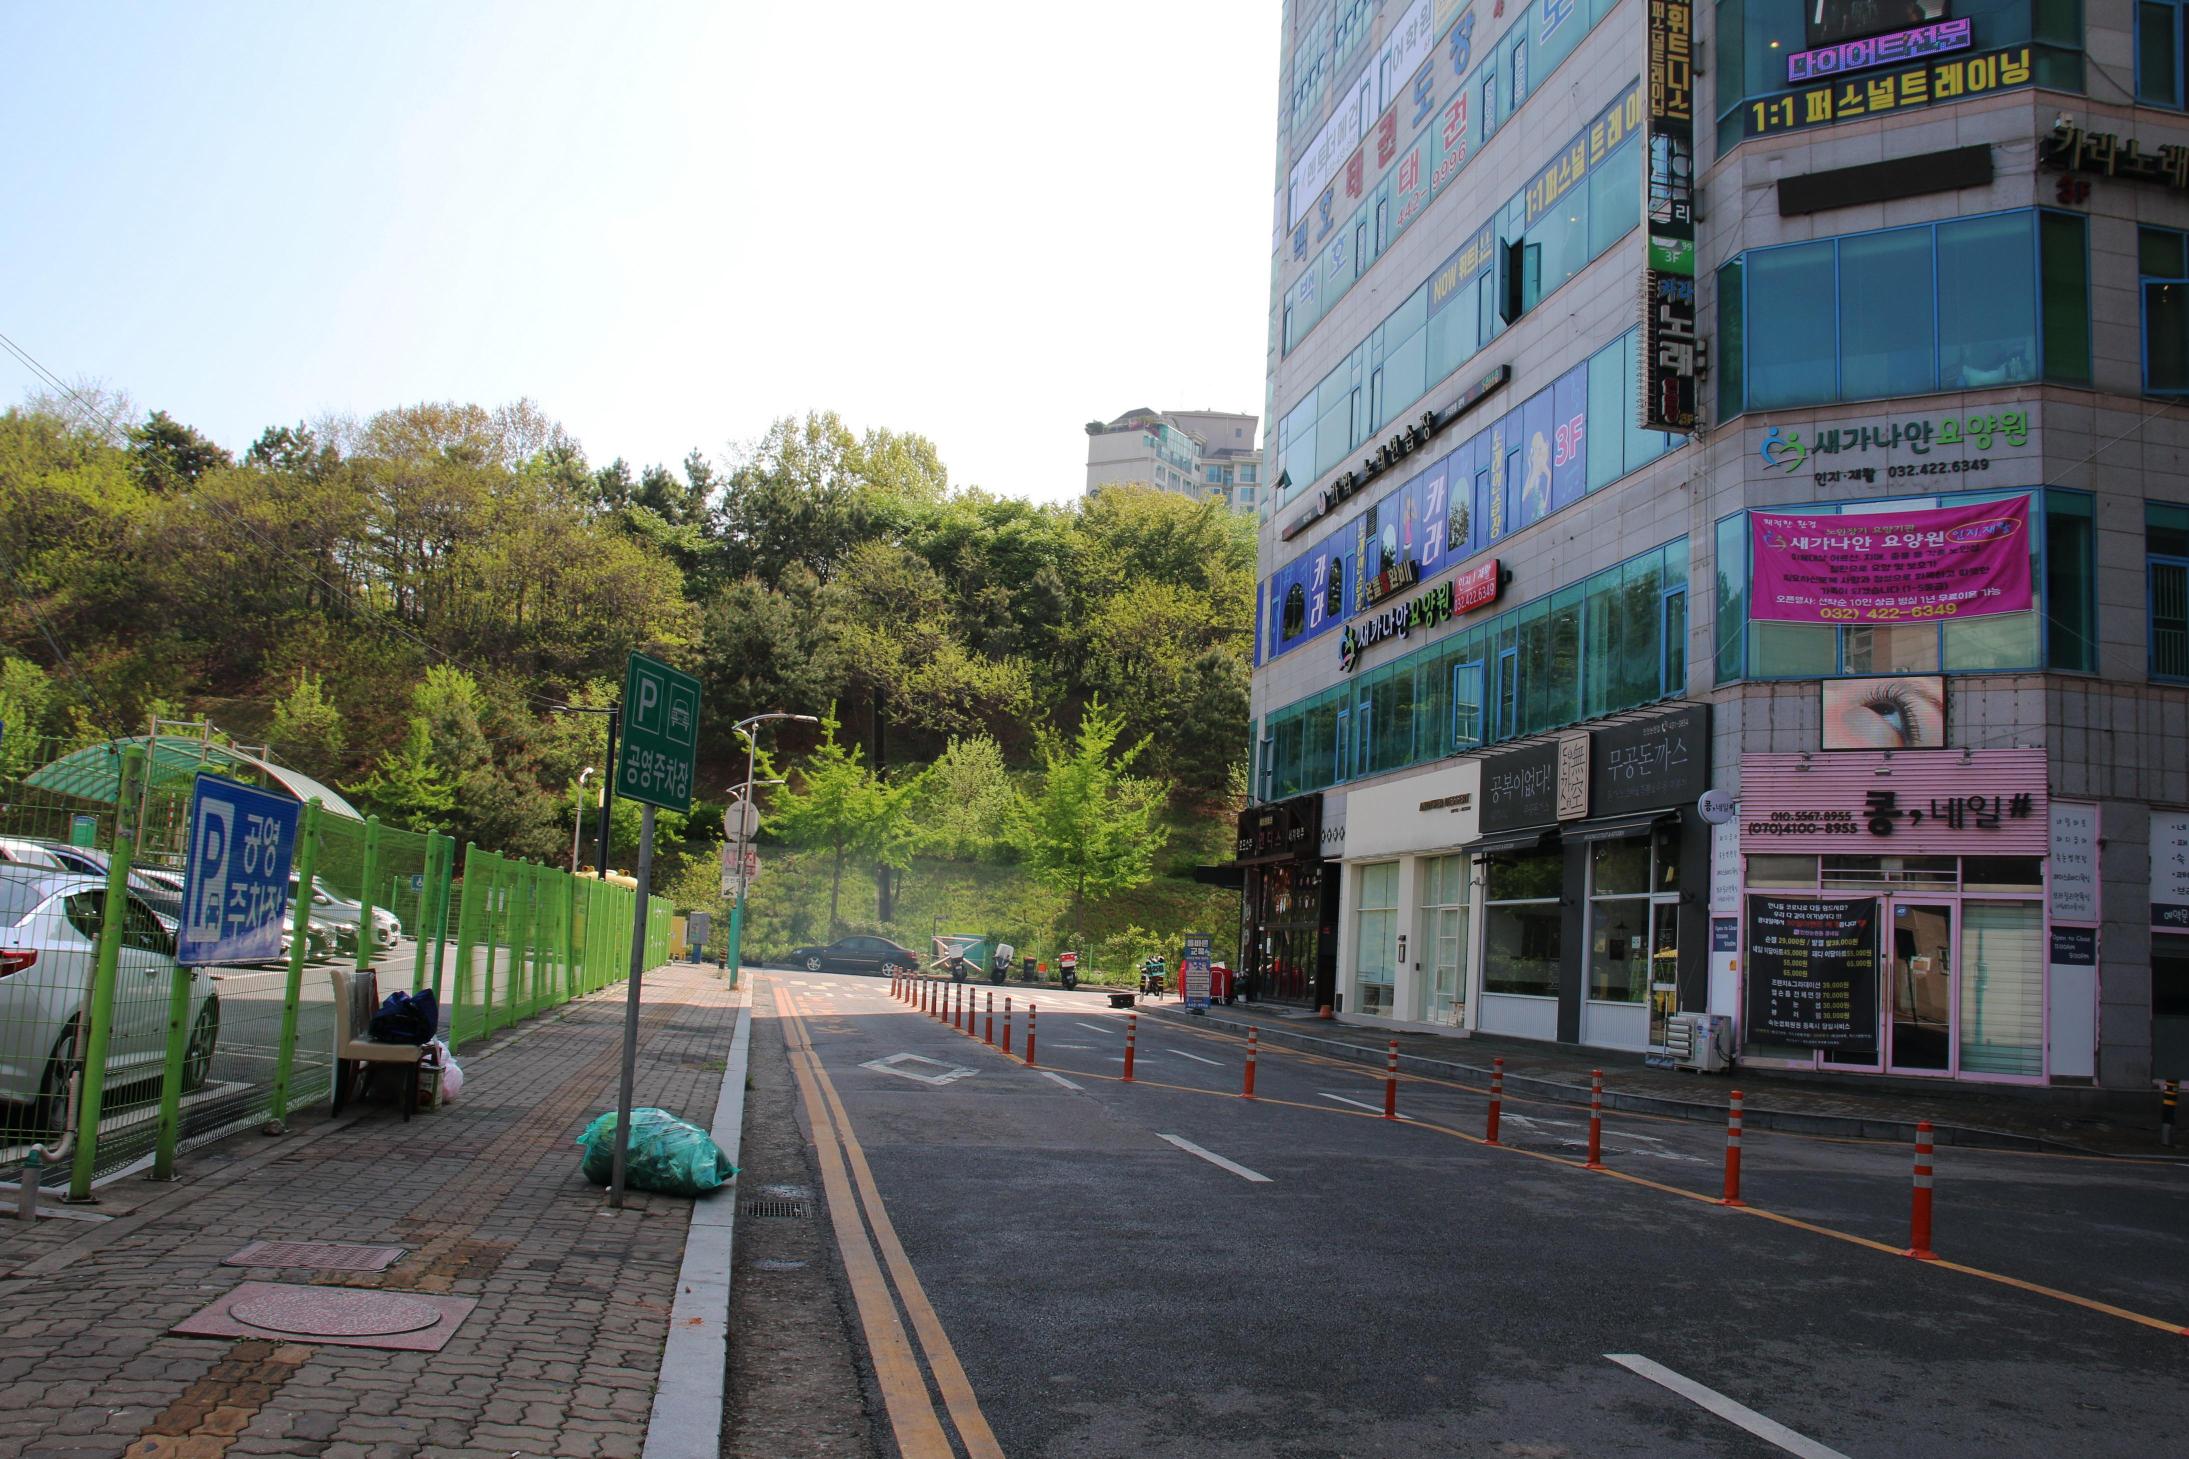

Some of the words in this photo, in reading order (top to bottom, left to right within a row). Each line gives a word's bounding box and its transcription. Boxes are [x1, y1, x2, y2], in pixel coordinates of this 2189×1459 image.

[1753, 97, 1794, 132] 1:1
[1806, 48, 2030, 122] 퍼스널트레이닝
[1665, 251, 1682, 263] 3F
[1434, 262, 1457, 304] NOW
[1659, 304, 1694, 377] 노래
[1555, 413, 1585, 467] 3F
[1888, 459, 1990, 479] 032.422.6349
[1421, 475, 1445, 567] 카라
[1791, 535, 1872, 552] 새가나안
[1881, 531, 1945, 549] 요양원
[1311, 553, 1327, 629] 카라
[1820, 608, 1860, 620] 032)
[1866, 603, 1958, 619] 422-6349
[638, 677, 658, 722] P
[627, 744, 689, 799] 공영주차장
[1608, 737, 1688, 781] 무공돈까스
[244, 814, 281, 878] 공영
[1748, 822, 1858, 836] (070)4100-8955
[227, 881, 284, 944] 주차장
